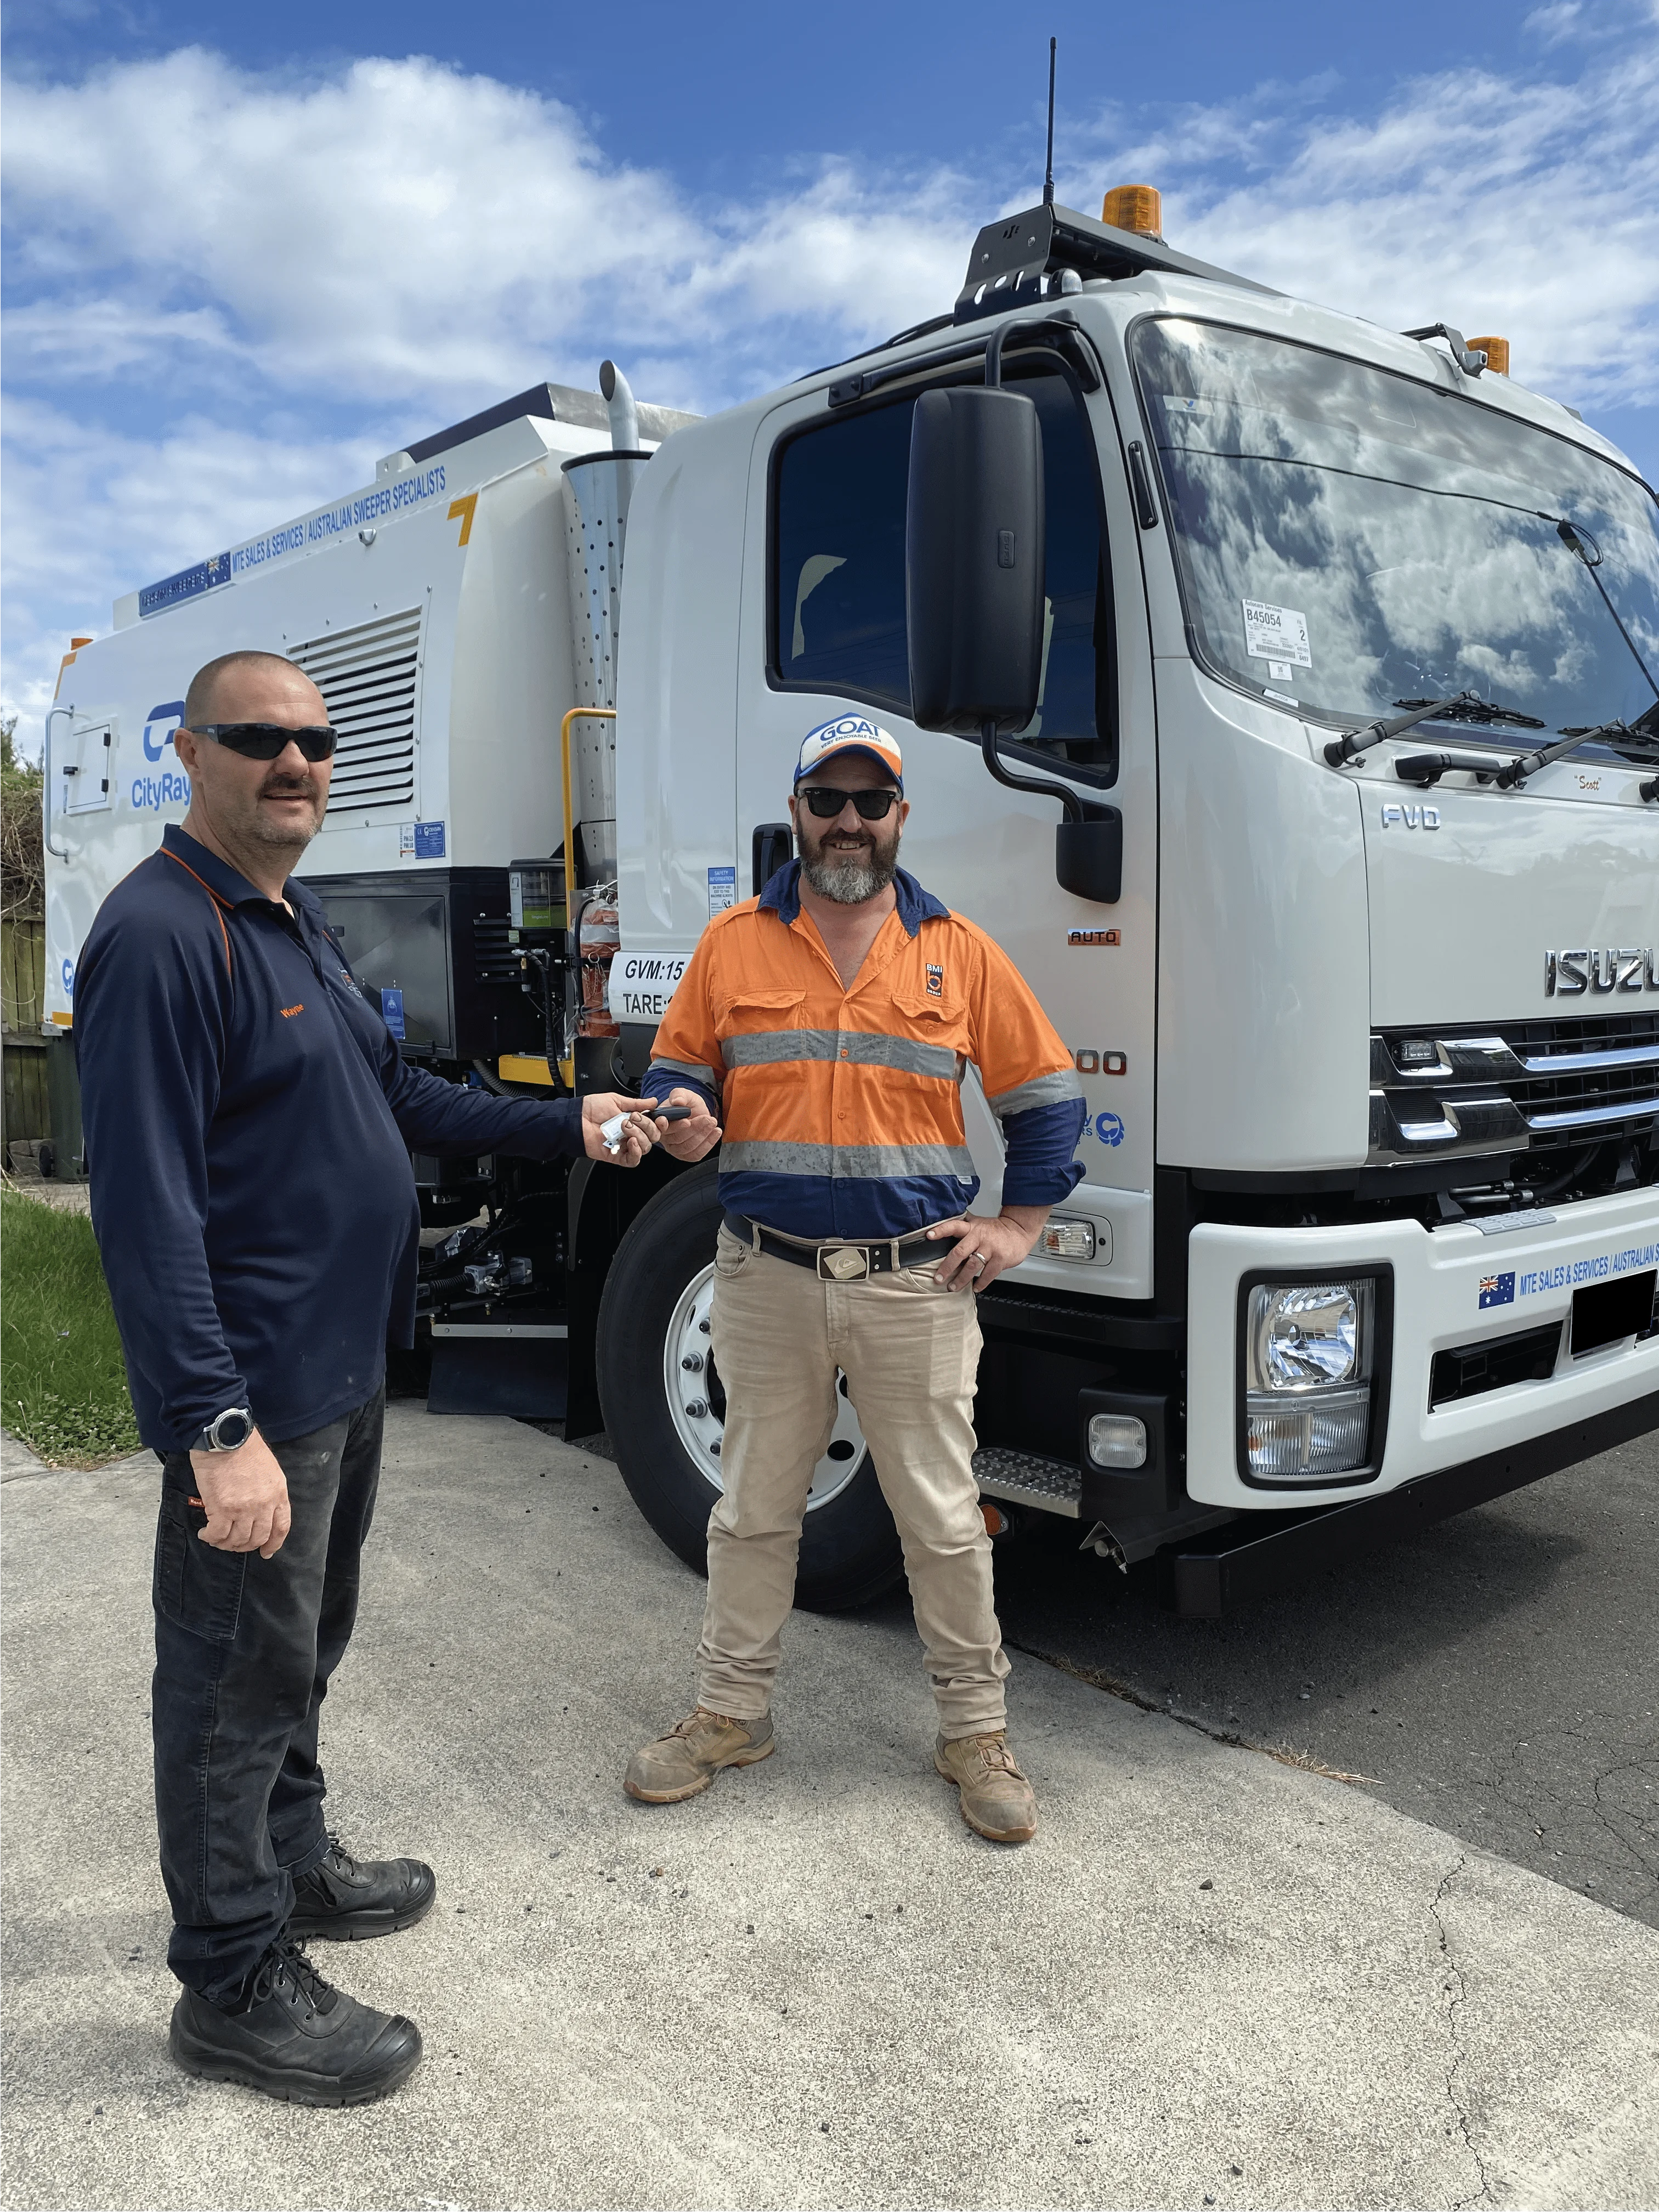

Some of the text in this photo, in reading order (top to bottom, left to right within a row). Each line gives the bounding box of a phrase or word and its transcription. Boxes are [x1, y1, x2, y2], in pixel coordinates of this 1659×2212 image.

[233, 550, 244, 573] MTE
[246, 541, 264, 568] SALES
[267, 538, 271, 558] &
[273, 524, 303, 556] SERVICES
[308, 504, 352, 542] AUSTRALIAN
[354, 489, 391, 524] SWEEPER
[393, 466, 445, 510] SPECIALISTS
[1247, 608, 1281, 627] B45054
[1300, 630, 1305, 641] 2
[820, 721, 880, 741] GOAT
[821, 739, 834, 748] VERY
[132, 773, 190, 811] CityRay
[1381, 804, 1441, 830] FVD
[1071, 932, 1116, 942] AUTO
[927, 964, 942, 972] BMI
[280, 1004, 305, 1018] Wayne
[623, 993, 673, 1015] TARE:
[1520, 1273, 1537, 1296] MTE
[1539, 1266, 1564, 1292] SALES
[1566, 1265, 1571, 1284] &
[1573, 1255, 1608, 1282] SERVICES
[1613, 1244, 1655, 1272] AUSTRALIAN
